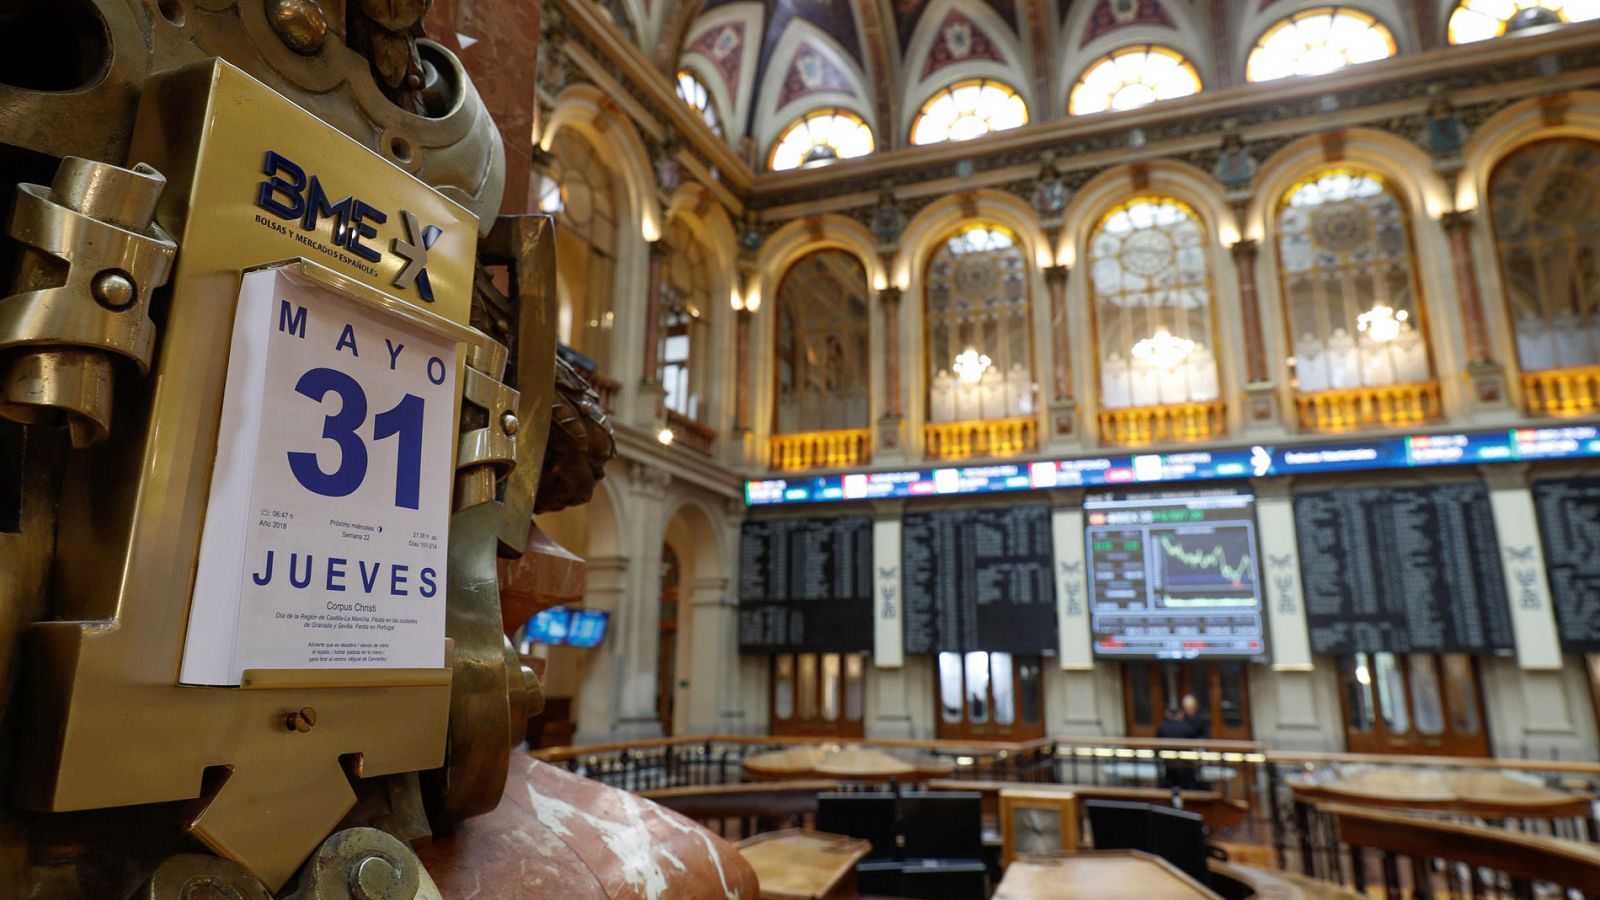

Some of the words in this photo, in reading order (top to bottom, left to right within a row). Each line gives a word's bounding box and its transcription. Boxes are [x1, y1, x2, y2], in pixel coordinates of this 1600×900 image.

[255, 214, 287, 235] BOLSAS
[288, 229, 295, 239] Y
[295, 232, 338, 258] MERCADOS
[338, 253, 378, 277] ESPAÑOLES
[278, 299, 446, 385] MAYO
[287, 367, 425, 510] 31
[272, 510, 288, 518] 06:47
[259, 519, 271, 528] Año
[272, 521, 287, 529] 2018
[342, 531, 363, 540] Semana
[252, 550, 437, 598] JUEVES
[326, 601, 353, 612] Corpus
[354, 602, 377, 613] Christi
[311, 621, 333, 629] Granada
